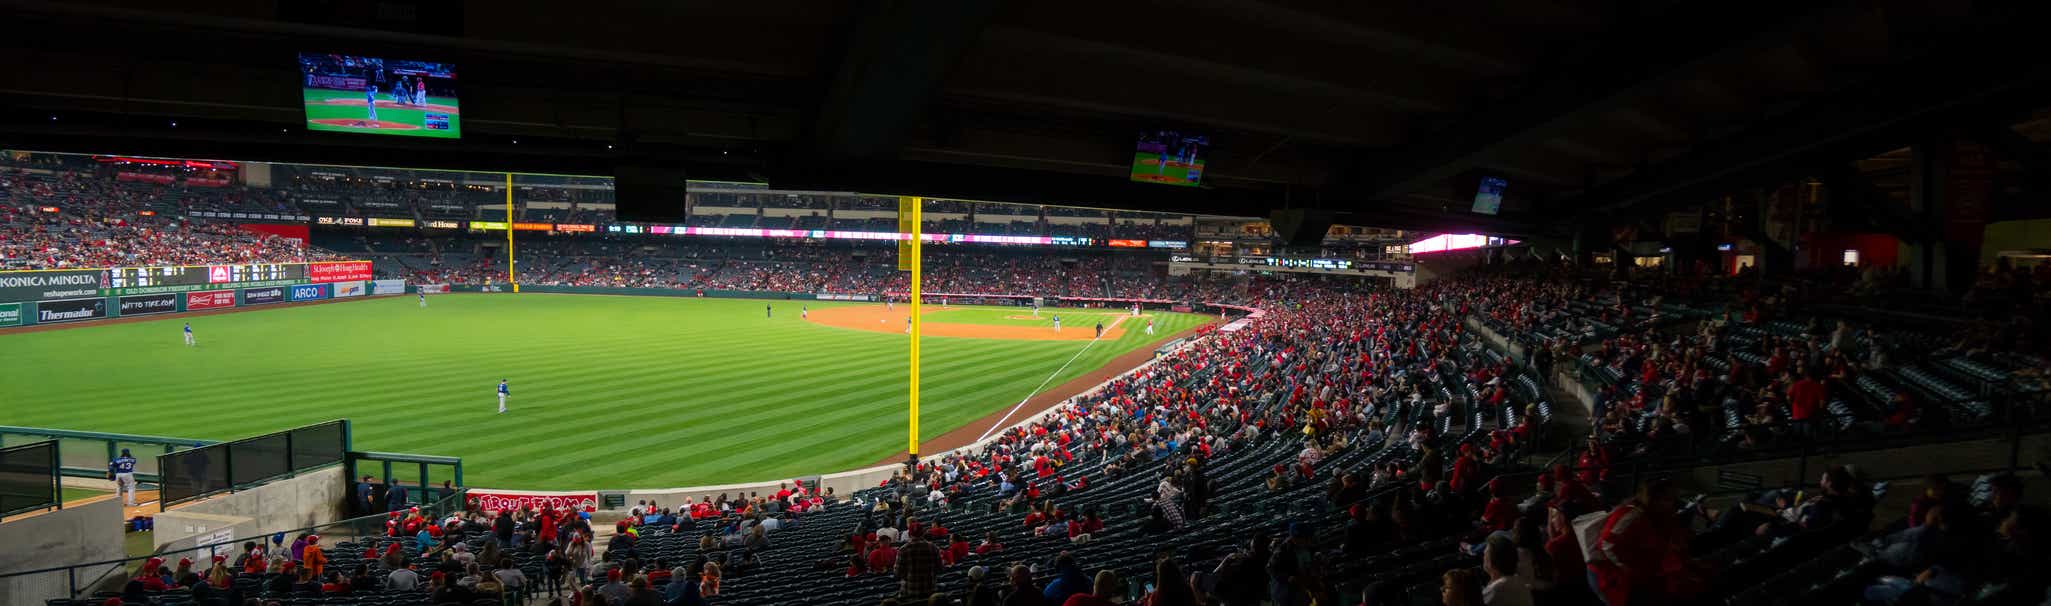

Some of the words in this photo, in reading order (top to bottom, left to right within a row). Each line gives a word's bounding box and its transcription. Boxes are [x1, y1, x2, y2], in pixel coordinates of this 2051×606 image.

[437, 221, 458, 229] House
[0, 276, 47, 288] KONICA
[48, 274, 97, 286] MINOLTA
[43, 289, 97, 298] reshapework.com
[294, 287, 318, 299] ARCO
[40, 307, 95, 321] Thermador
[120, 462, 132, 470] 43
[480, 494, 530, 512] TROUT
[531, 496, 581, 512] FRM
